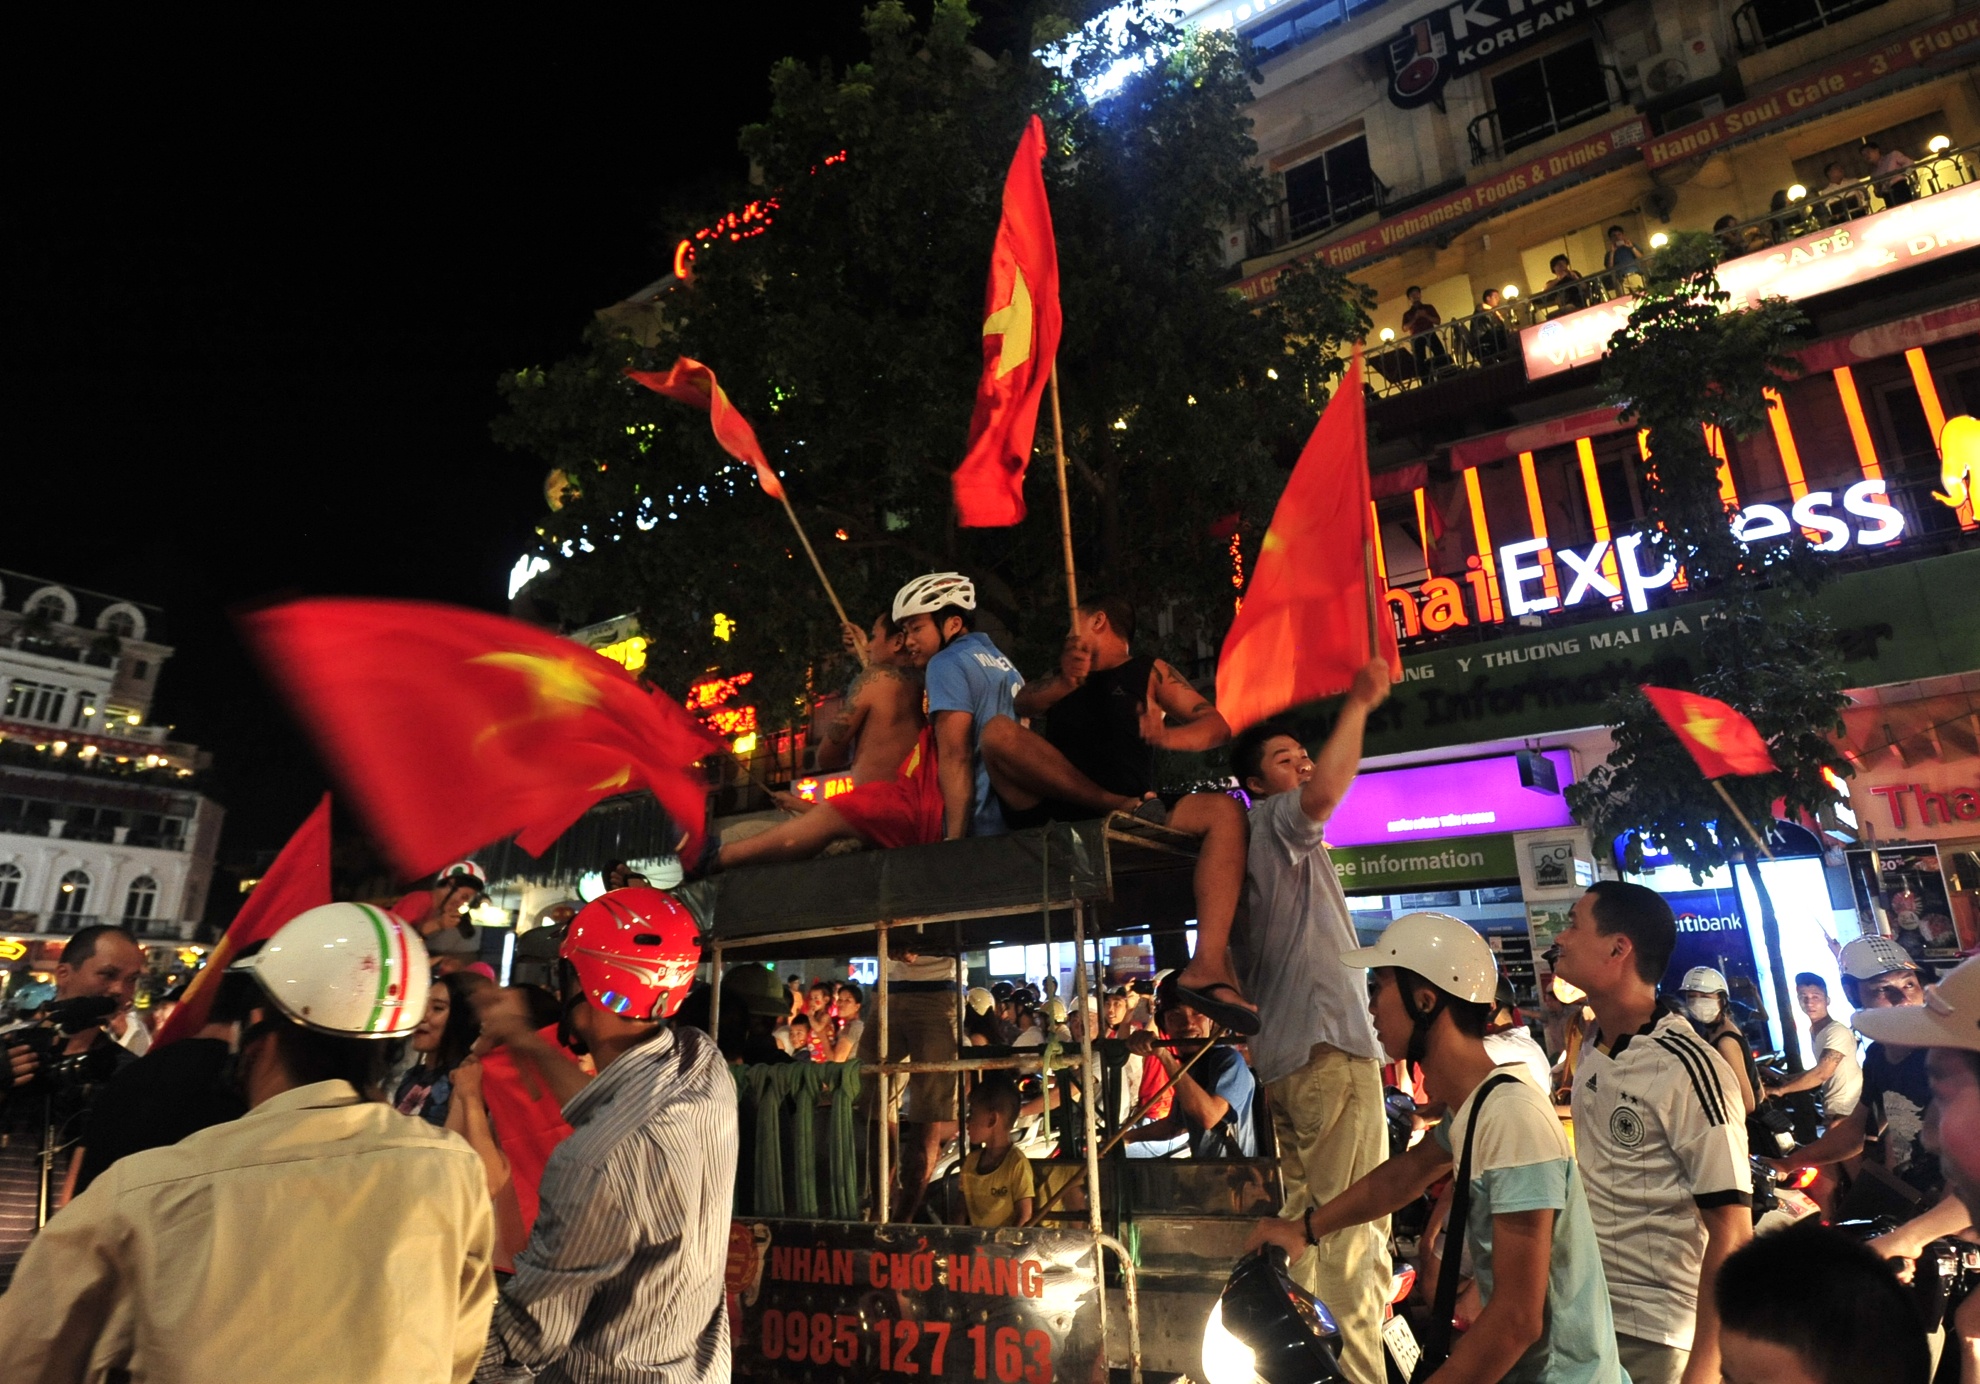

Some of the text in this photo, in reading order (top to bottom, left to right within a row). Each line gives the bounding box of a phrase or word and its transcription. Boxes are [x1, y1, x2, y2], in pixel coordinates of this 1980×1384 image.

[1457, 1, 1576, 66] KOREAN
[1651, 122, 1720, 163] Hanoi
[1725, 98, 1781, 133] Soul
[1786, 73, 1845, 107] Cafe
[1909, 18, 1979, 60] Floor
[1329, 239, 1367, 266] Floor
[1380, 194, 1473, 245] Vietnamese
[1476, 173, 1527, 207] Foods
[1531, 164, 1546, 183] &
[1549, 138, 1607, 171] Drinks
[1500, 479, 1905, 613] Expess
[1589, 627, 1641, 650] MẠI
[1336, 849, 1483, 877] ee information
[771, 1238, 1044, 1299] NHÂN CHỞ HÀNG
[762, 1309, 1053, 1384] 0985 127 163
